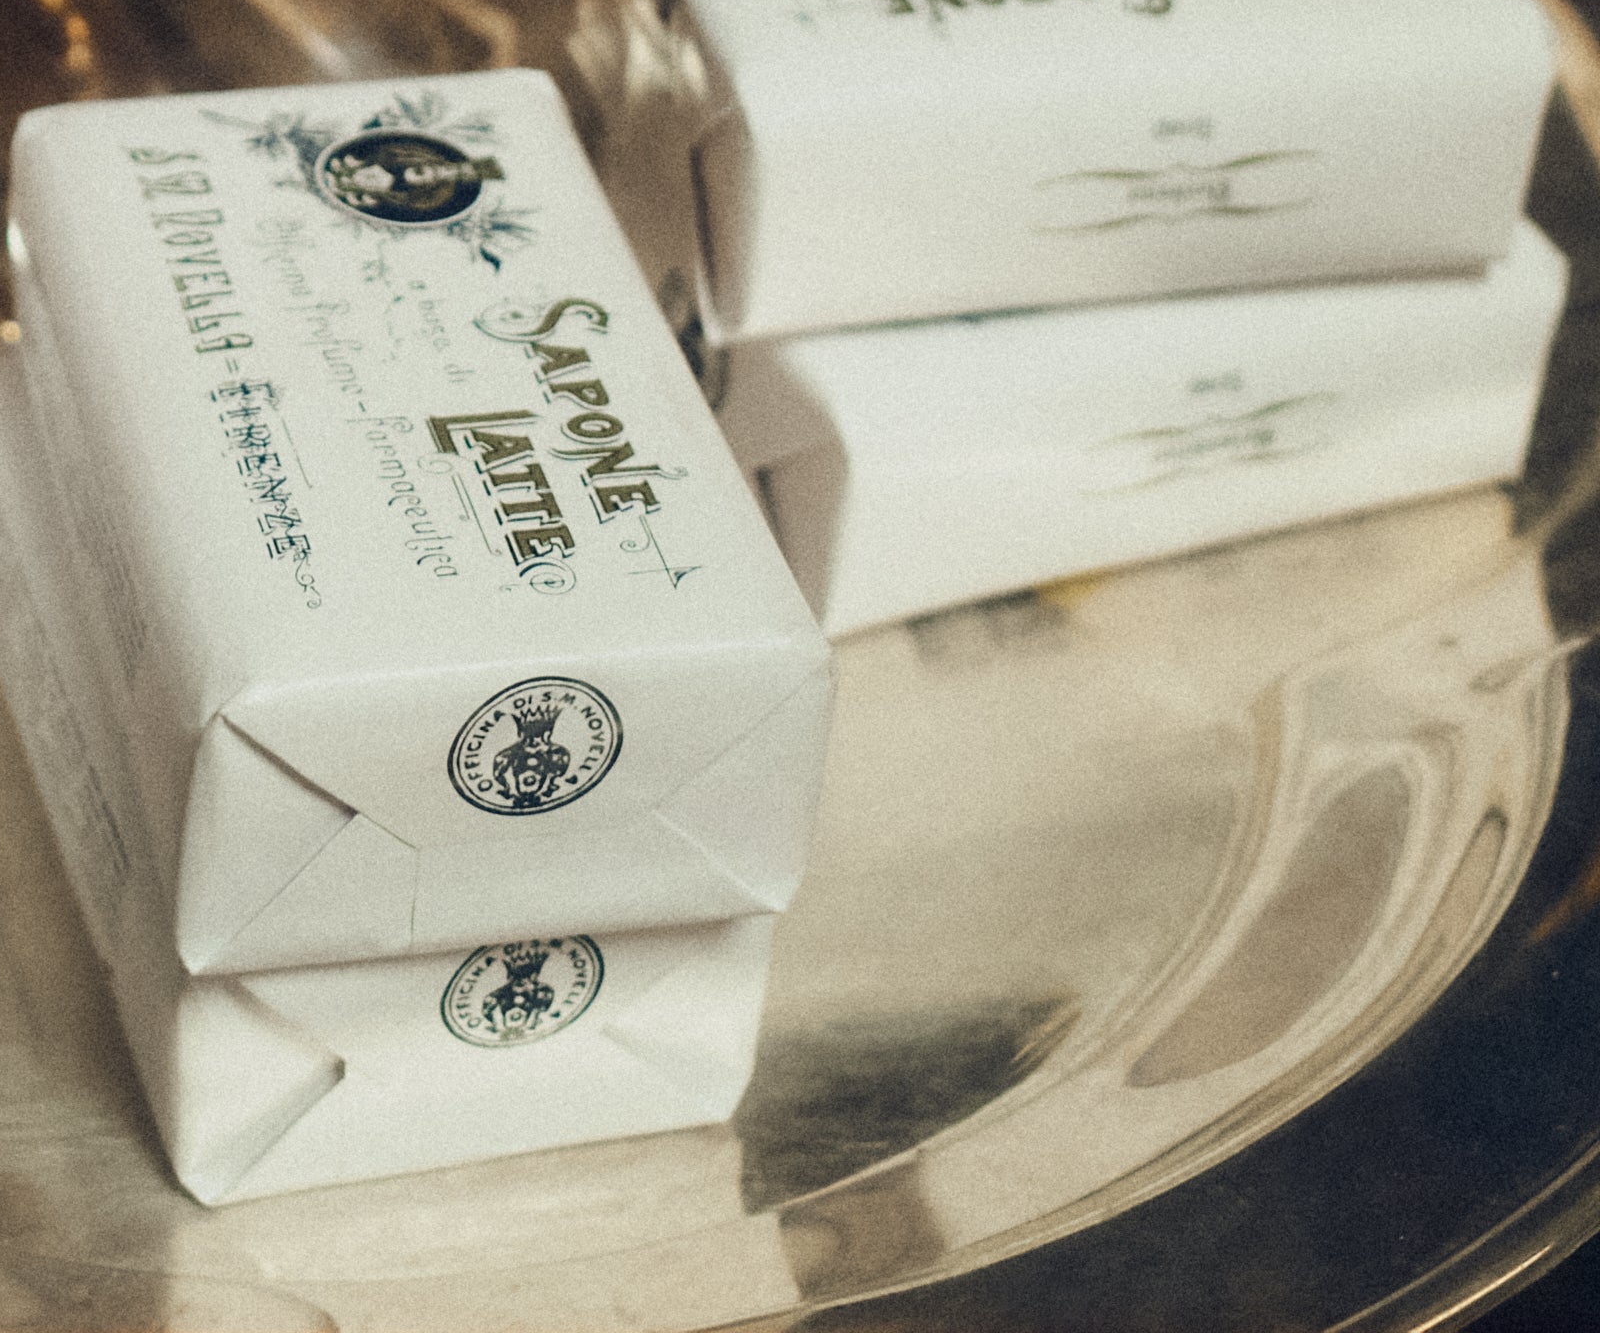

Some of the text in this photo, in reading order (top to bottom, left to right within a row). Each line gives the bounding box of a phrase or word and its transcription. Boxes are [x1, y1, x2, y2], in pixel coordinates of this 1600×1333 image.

[426, 409, 577, 595] LATTE
[475, 296, 688, 524] SAPONE
[466, 709, 507, 794] OFFICINA
[512, 694, 534, 711] DI
